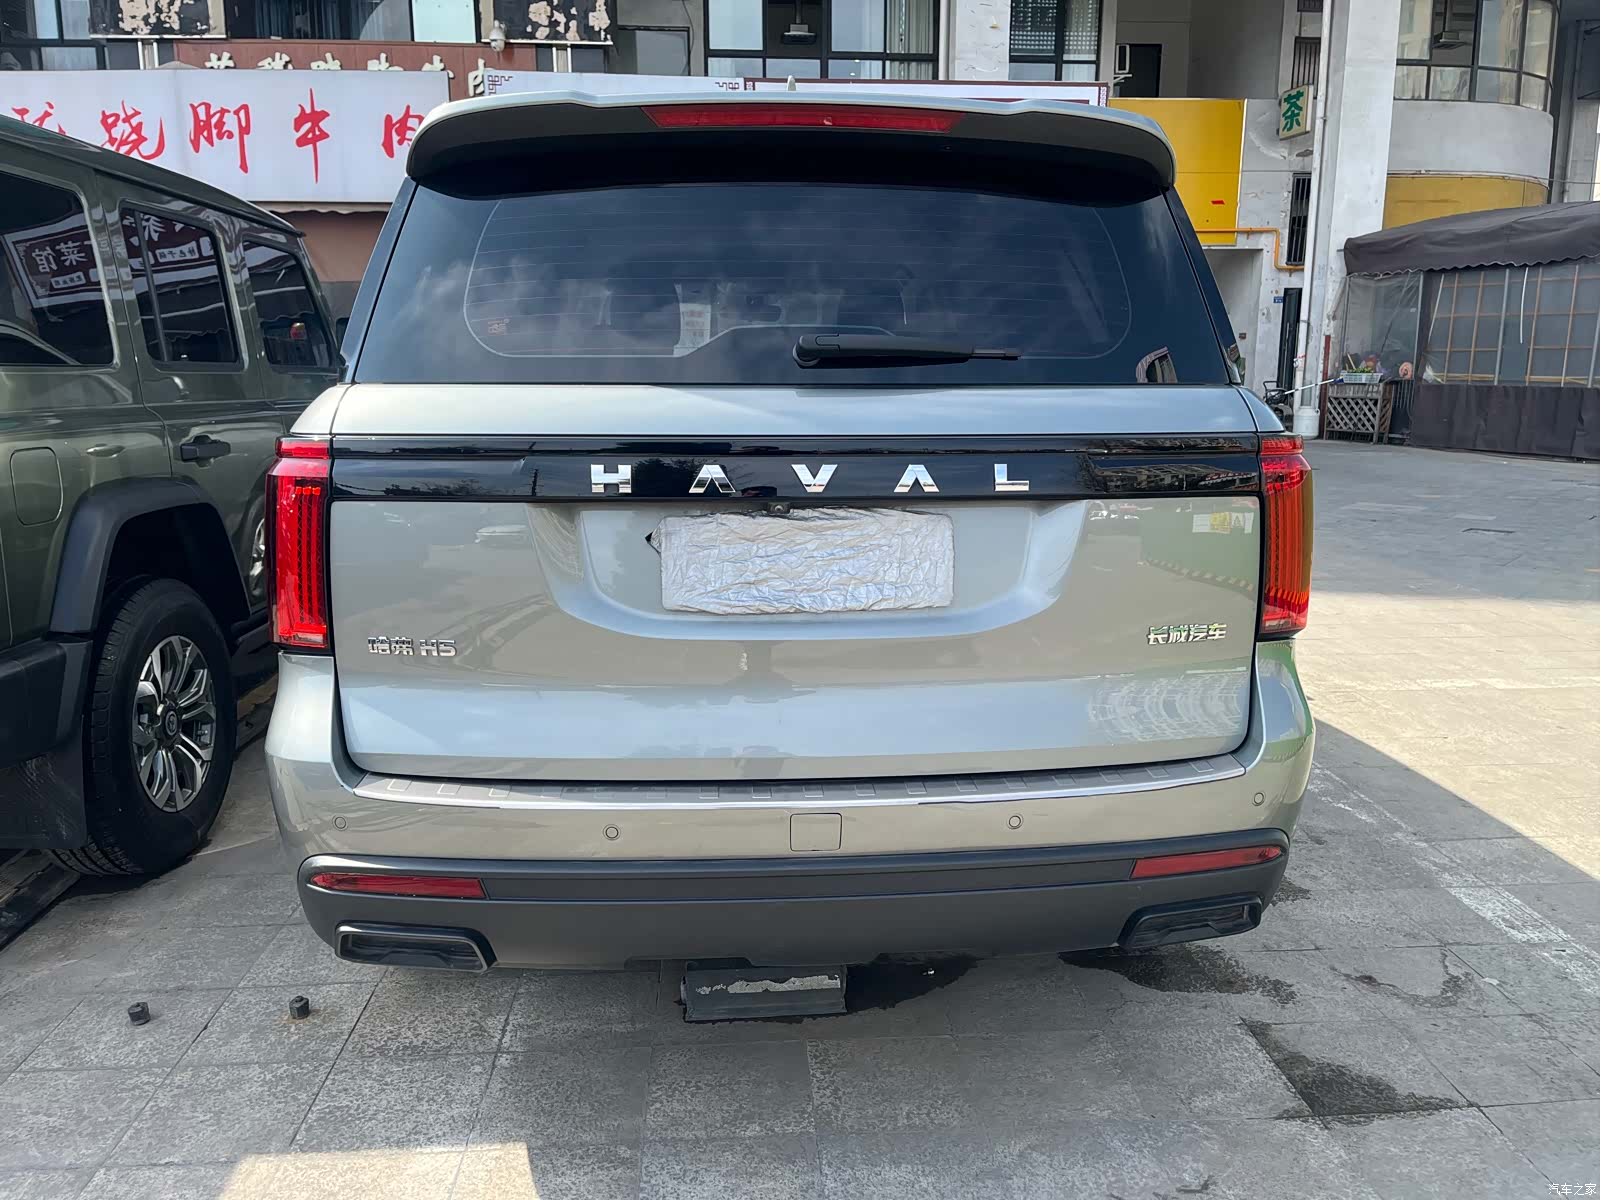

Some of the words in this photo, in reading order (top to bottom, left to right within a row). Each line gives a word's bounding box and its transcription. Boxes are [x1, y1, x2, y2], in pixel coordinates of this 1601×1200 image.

[1282, 90, 1304, 132] 茶
[590, 464, 1029, 493] HAVAL
[1147, 623, 1227, 645] 长城汽车
[420, 639, 456, 656] H5
